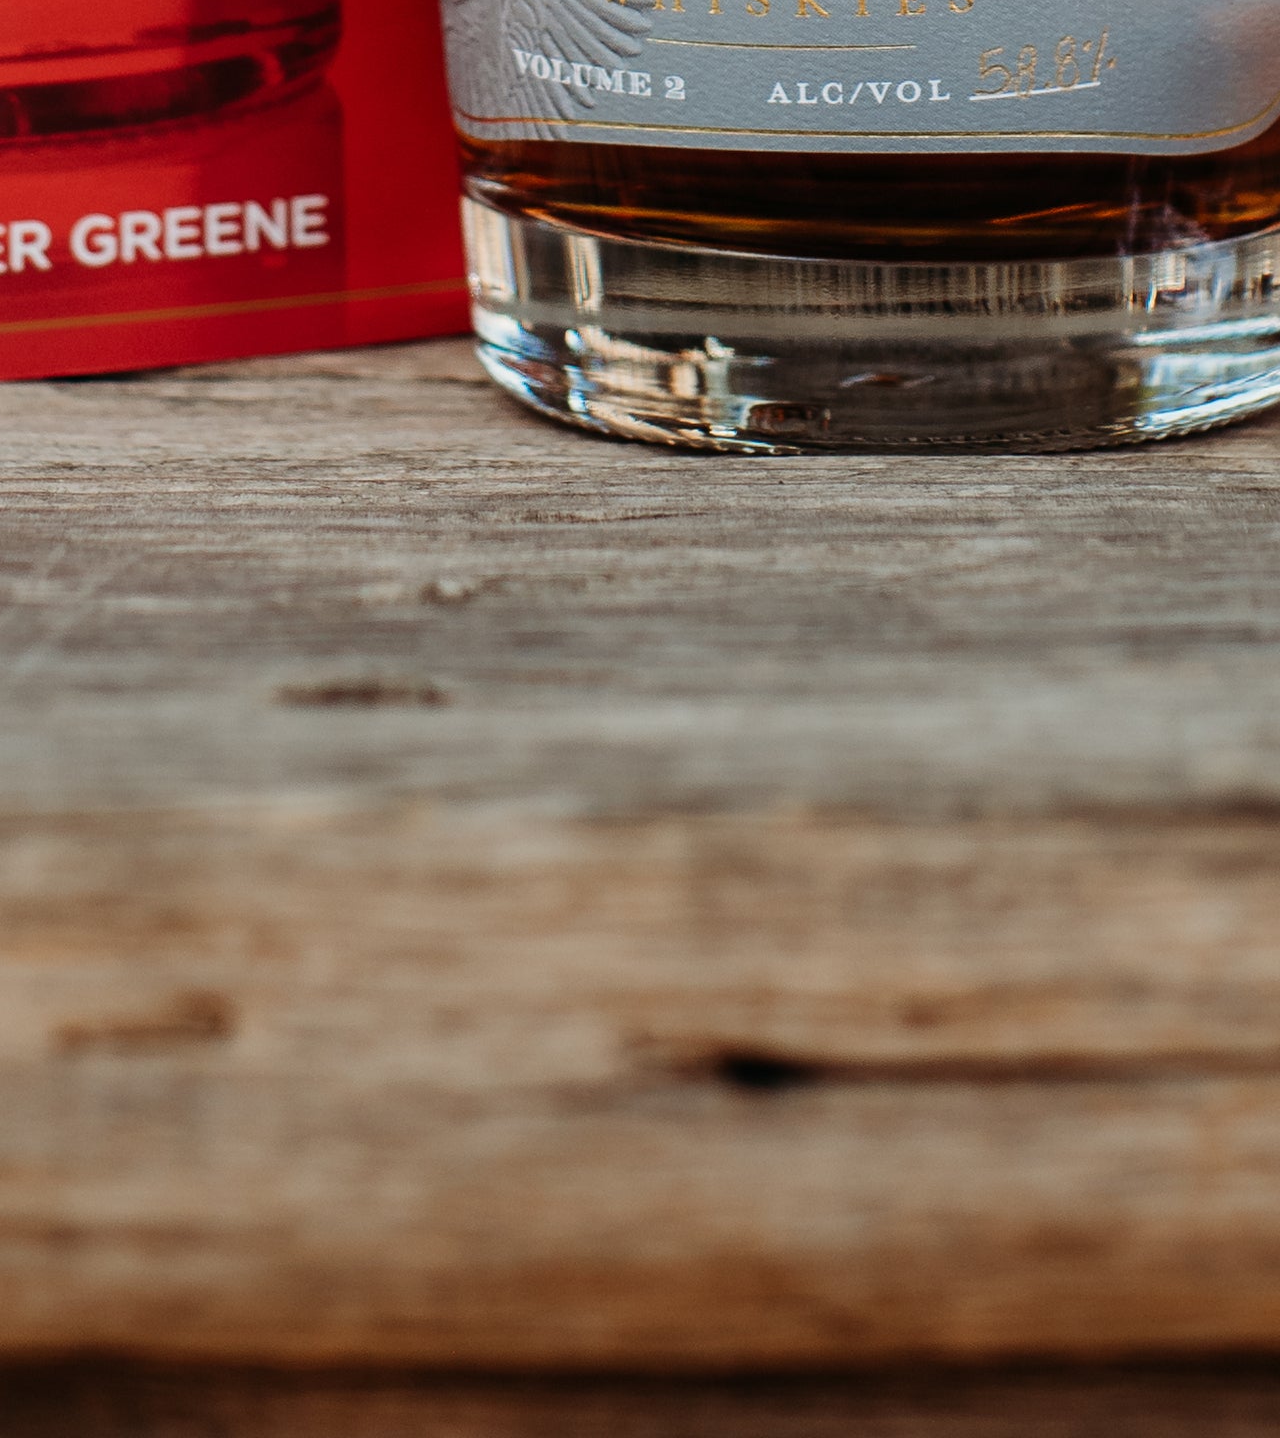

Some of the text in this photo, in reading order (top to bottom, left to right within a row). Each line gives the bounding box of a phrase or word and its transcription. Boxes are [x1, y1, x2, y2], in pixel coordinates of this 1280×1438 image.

[511, 48, 687, 101] VOLUME 2
[766, 77, 951, 106] ALC/VOL
[70, 194, 331, 268] GREENE
